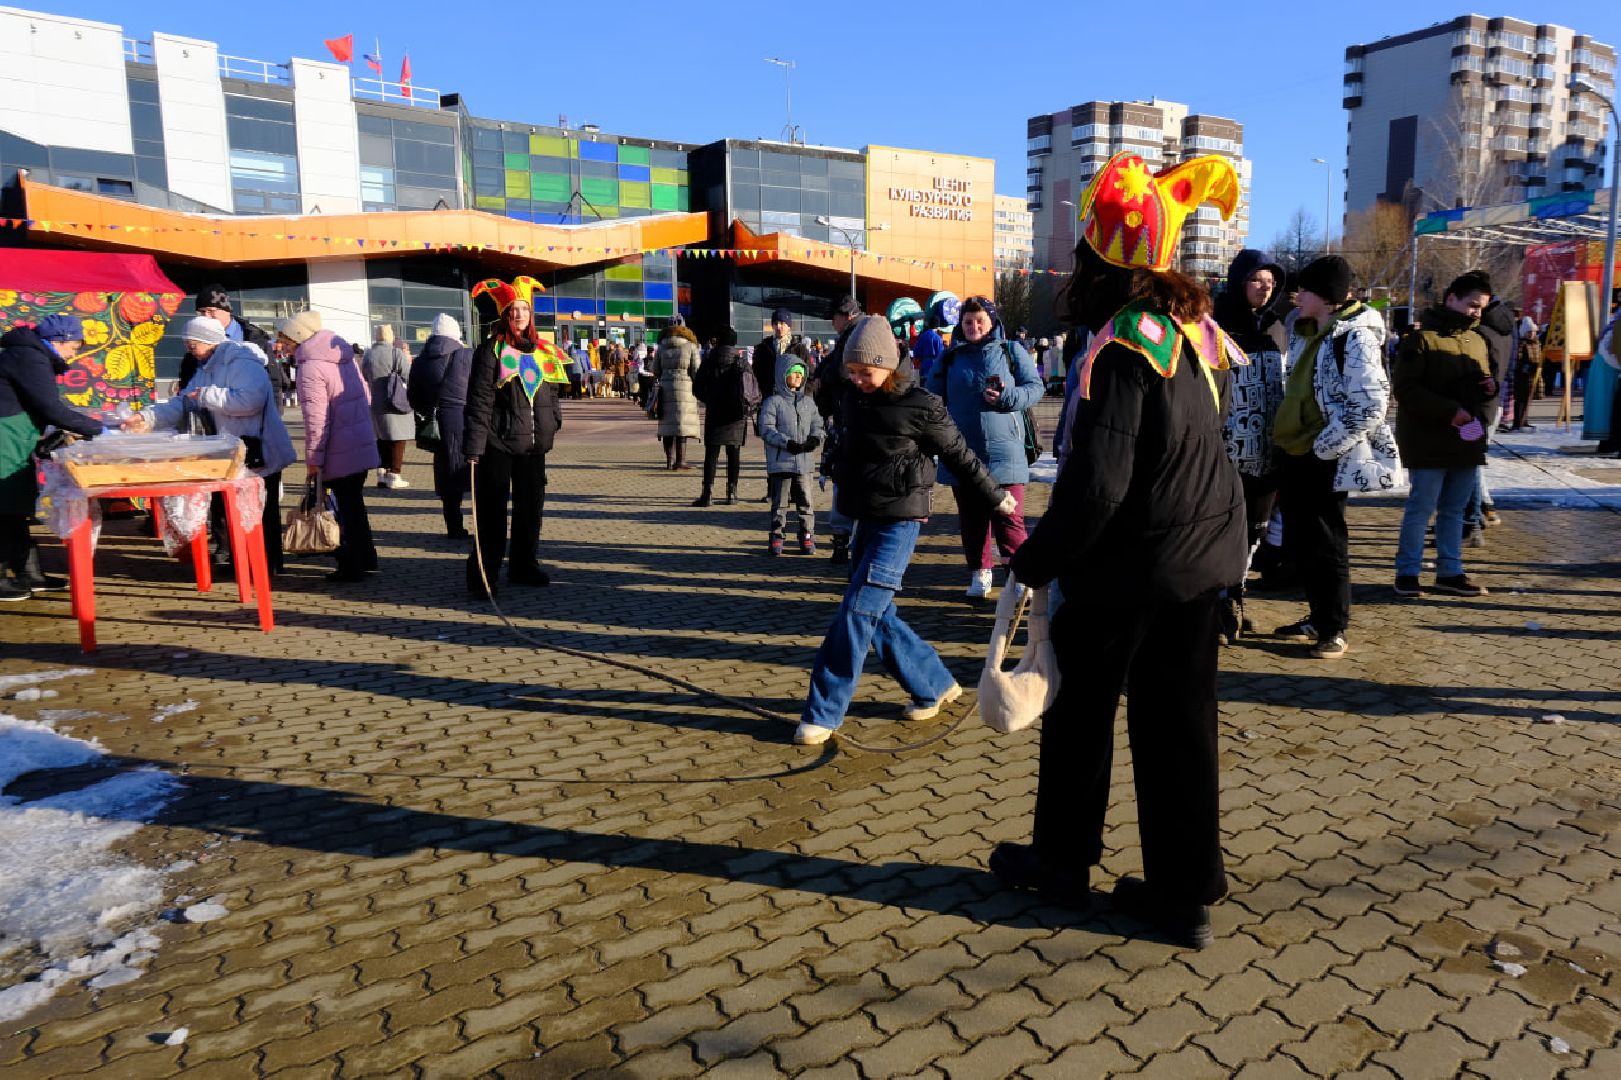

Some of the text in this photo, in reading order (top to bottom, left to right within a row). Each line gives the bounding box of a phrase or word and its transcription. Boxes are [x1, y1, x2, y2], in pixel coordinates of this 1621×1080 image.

[933, 177, 972, 192] ЦЕНТР
[889, 187, 972, 207] КУЛЬТУРНОГО
[909, 204, 972, 221] РАЗВИТИЯ
